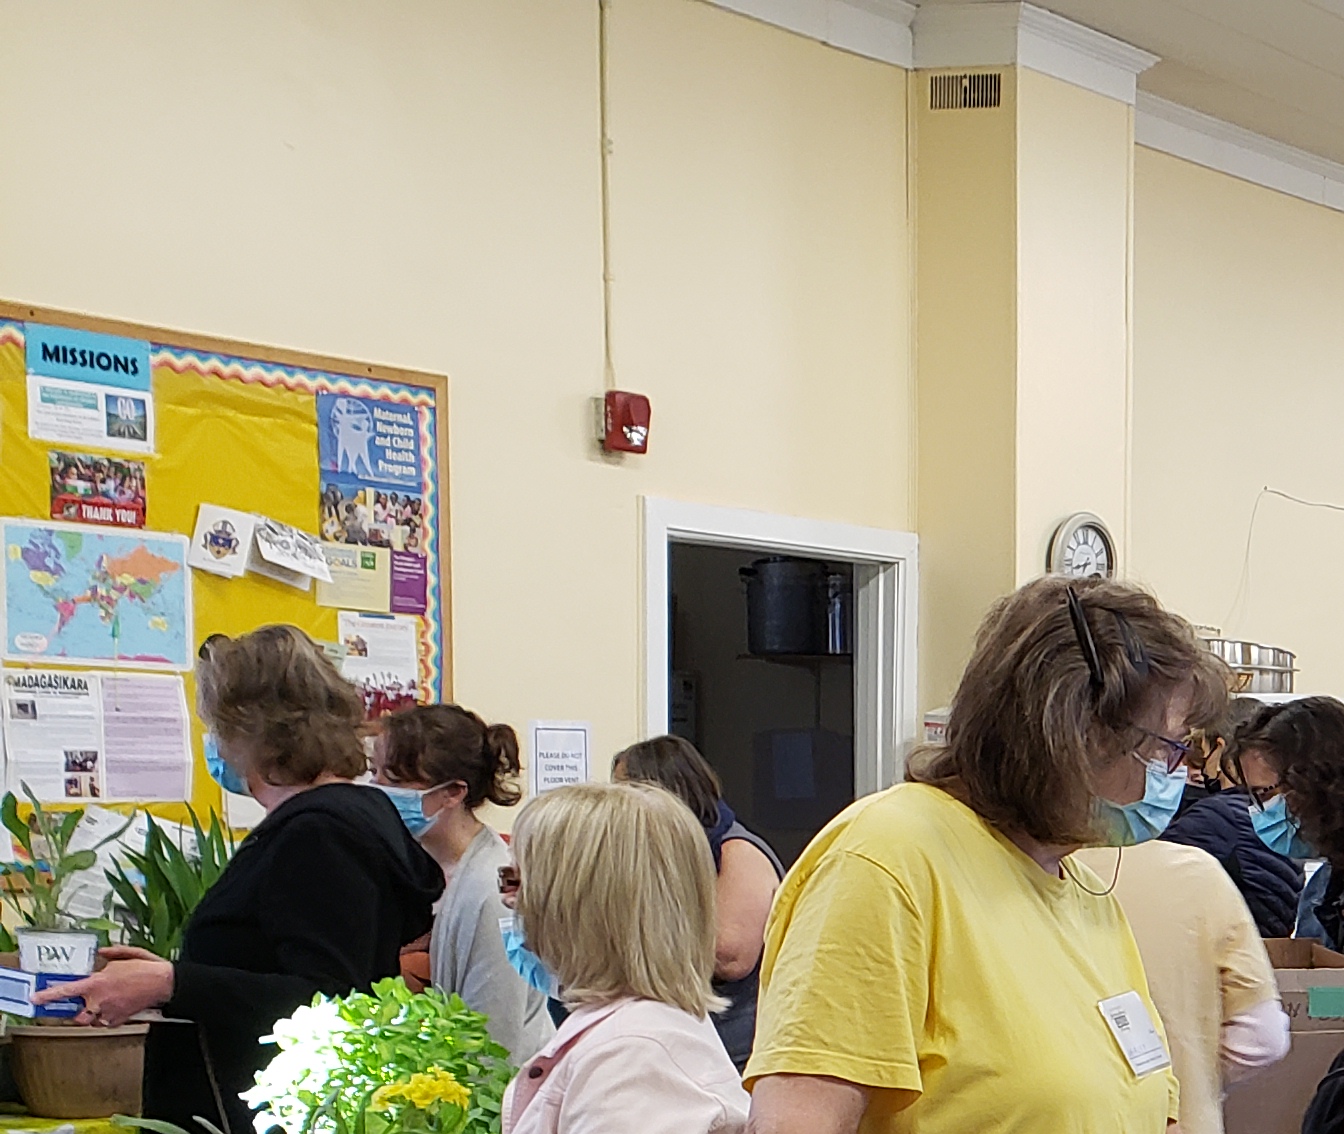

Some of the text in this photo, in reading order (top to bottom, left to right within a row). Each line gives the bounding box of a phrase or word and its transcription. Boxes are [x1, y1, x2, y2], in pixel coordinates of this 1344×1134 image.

[41, 341, 139, 377] MISSIONS
[376, 421, 414, 437] Newborn
[374, 435, 415, 450] and Child
[385, 448, 415, 463] Health
[378, 459, 416, 476] Program
[81, 503, 137, 524] THANK YOU!
